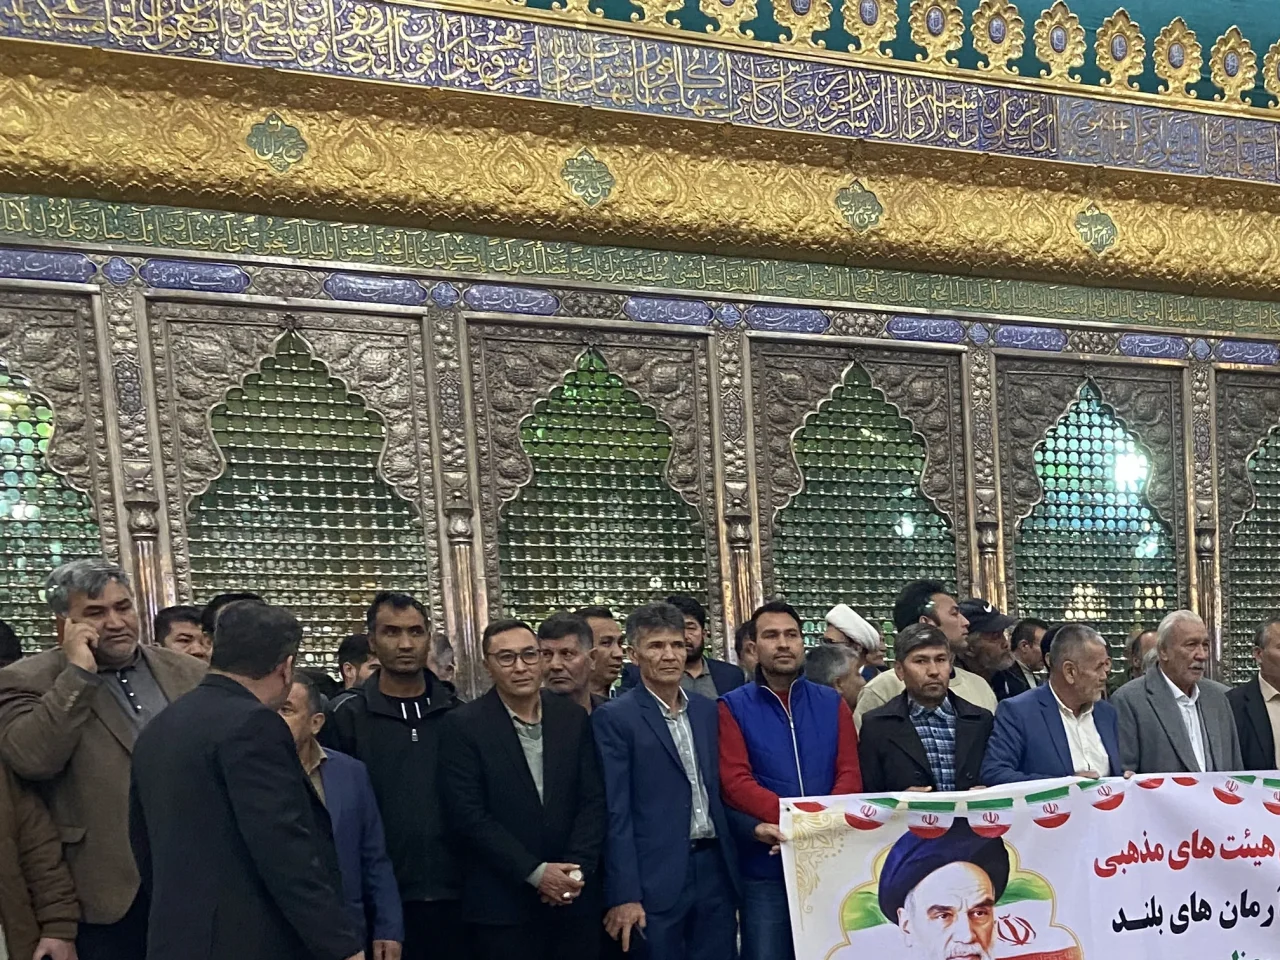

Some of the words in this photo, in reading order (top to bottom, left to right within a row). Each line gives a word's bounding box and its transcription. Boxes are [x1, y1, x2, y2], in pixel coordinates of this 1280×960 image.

[1094, 830, 1164, 878] مذهبی
[1168, 828, 1215, 870] های
[1219, 828, 1275, 867] هیئت
[1112, 895, 1164, 935] بلند
[1170, 891, 1212, 934] های
